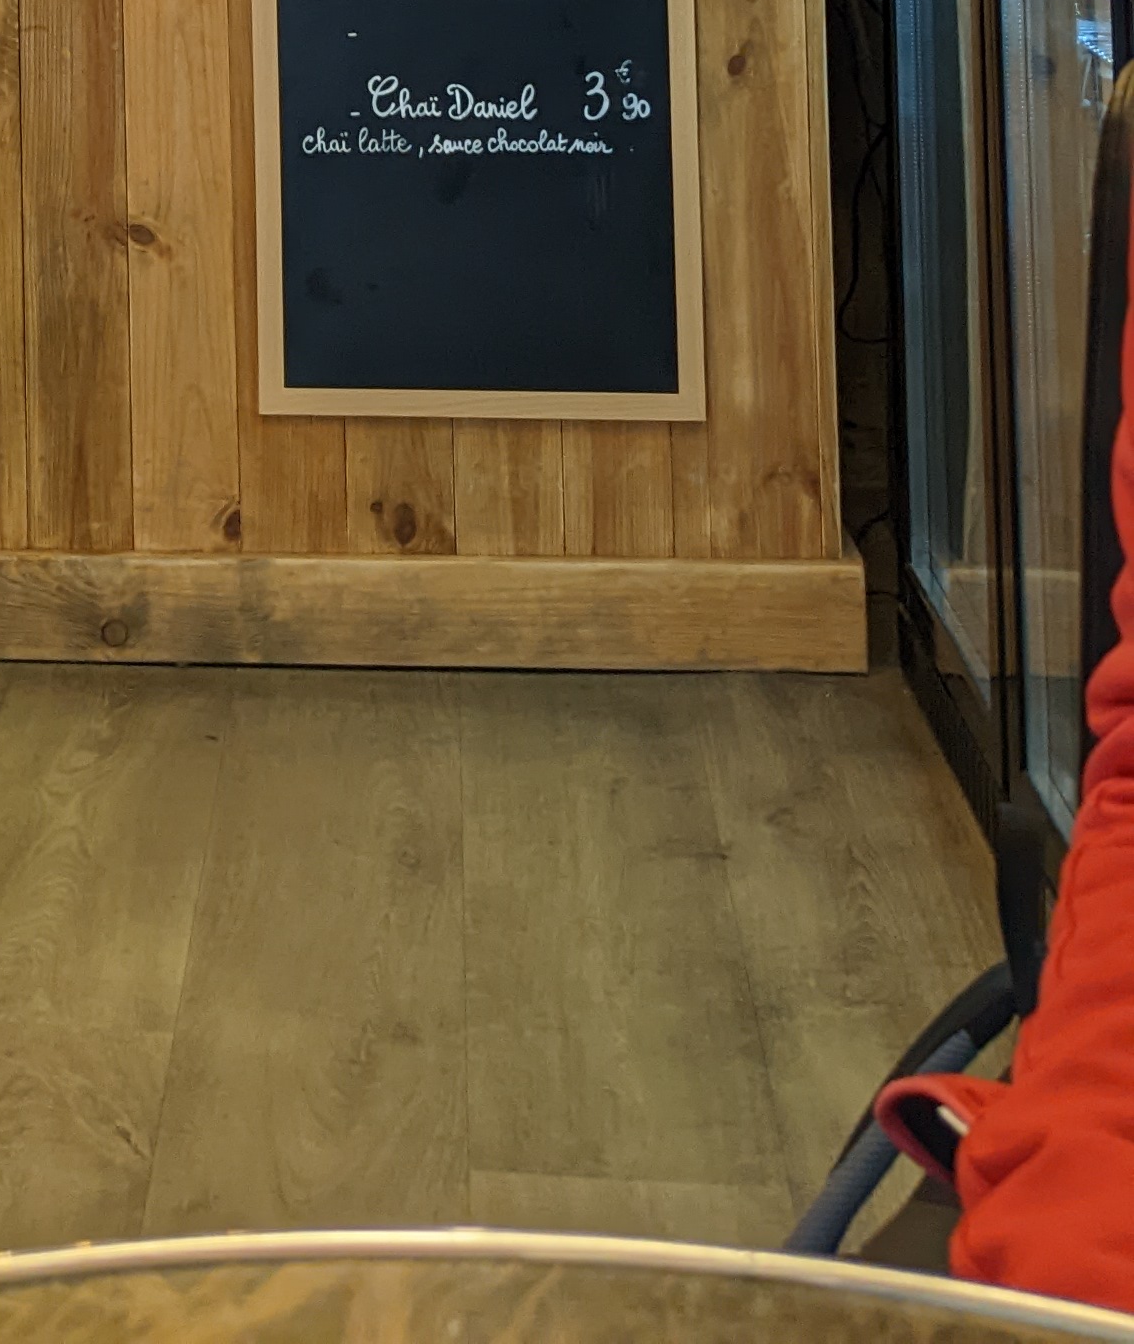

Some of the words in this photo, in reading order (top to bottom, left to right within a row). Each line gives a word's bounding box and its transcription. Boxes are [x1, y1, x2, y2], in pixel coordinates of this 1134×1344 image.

[446, 83, 538, 121] Daniel
[427, 133, 484, 154] sauce
[487, 127, 569, 153] chocolat
[567, 131, 613, 154] noir
